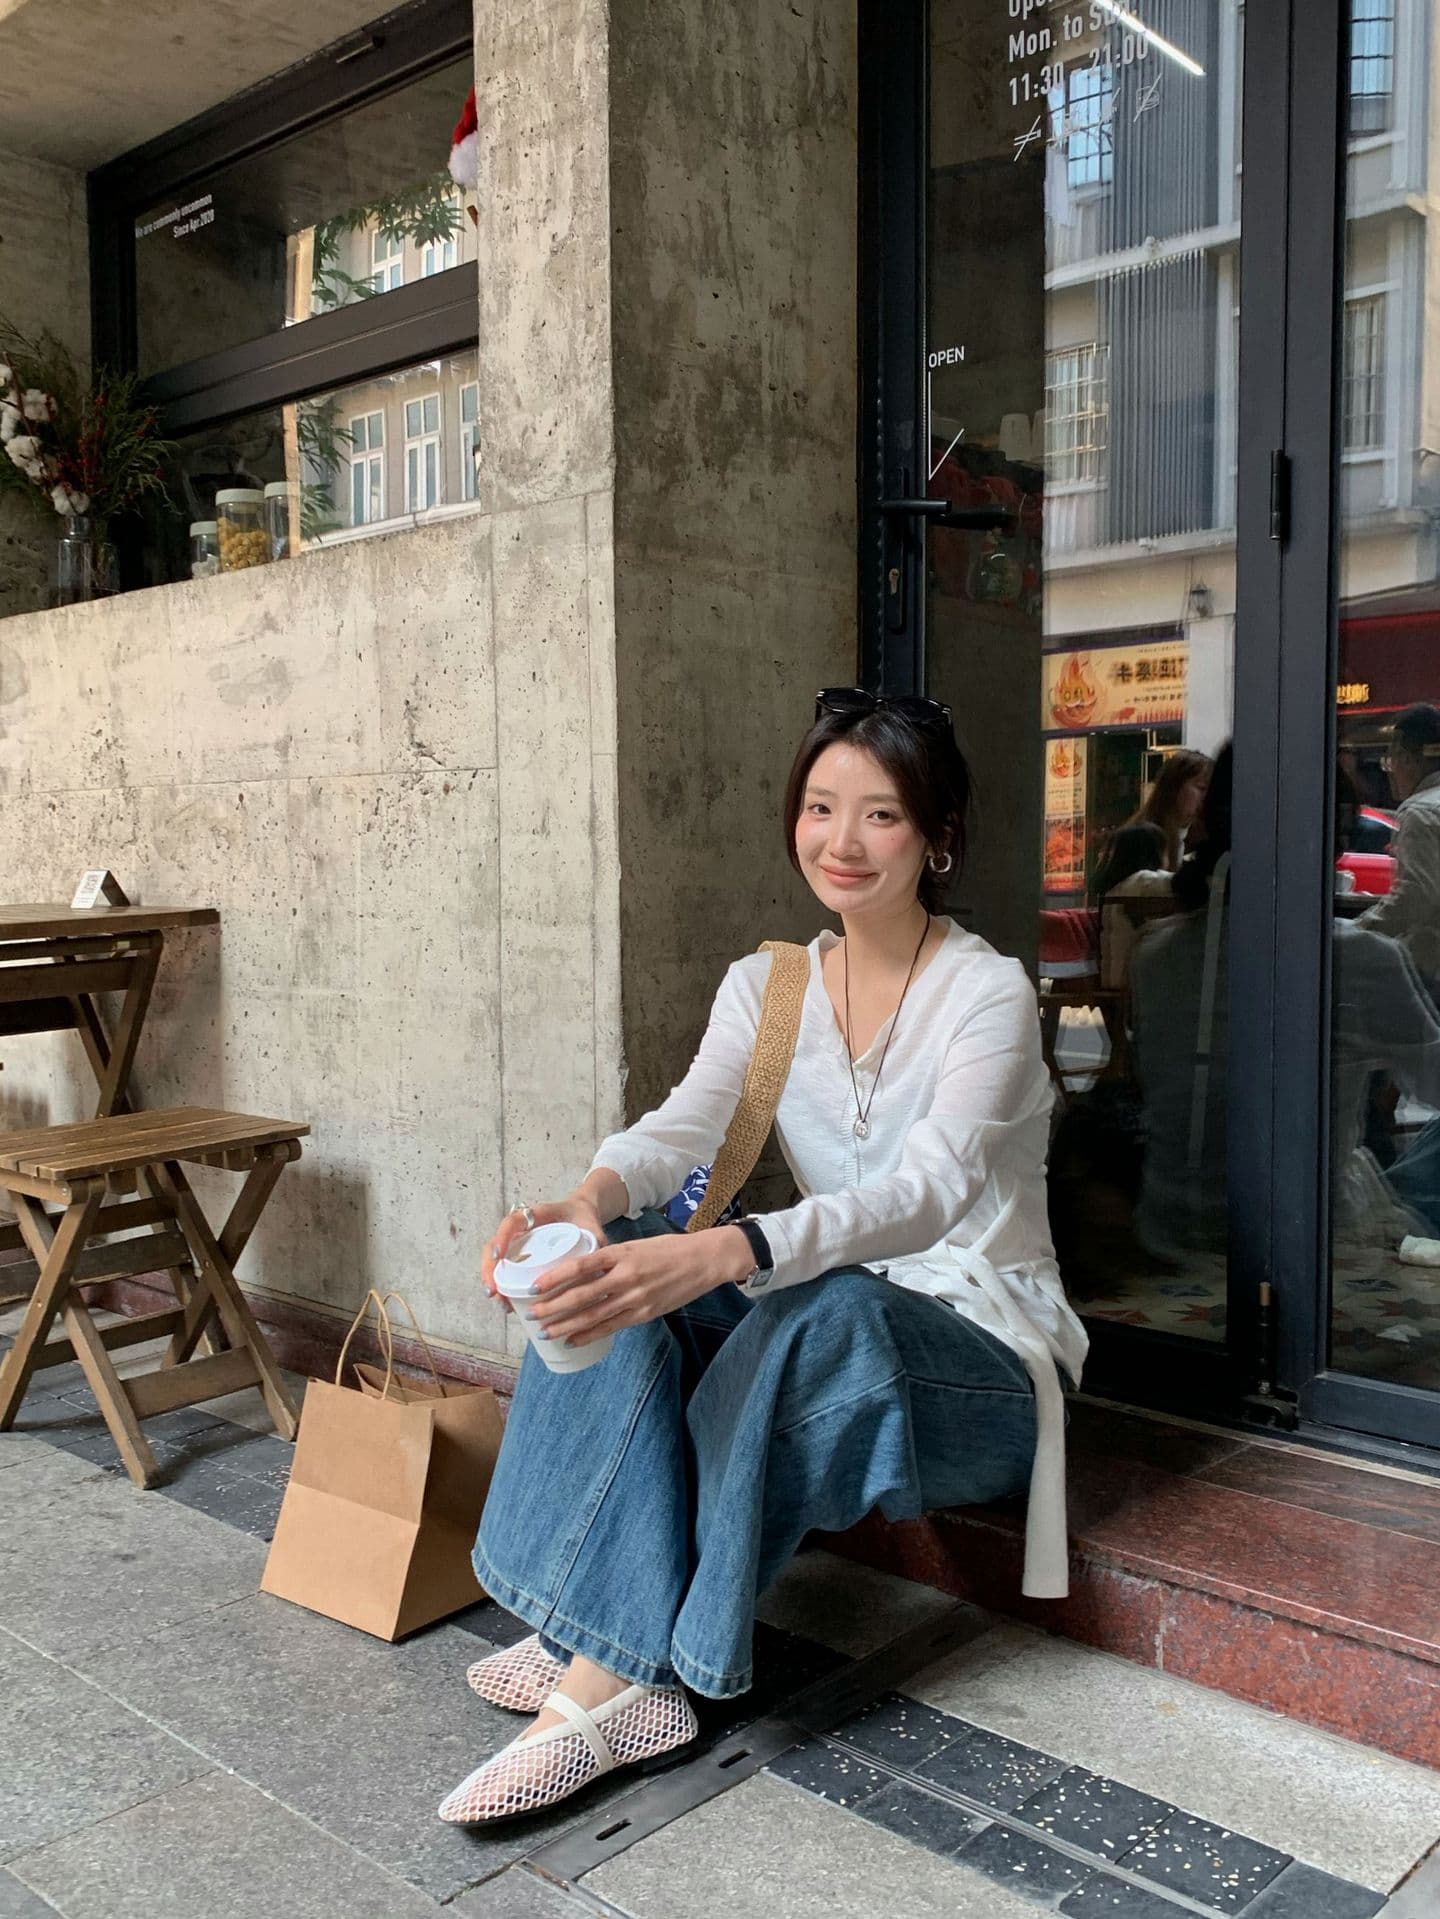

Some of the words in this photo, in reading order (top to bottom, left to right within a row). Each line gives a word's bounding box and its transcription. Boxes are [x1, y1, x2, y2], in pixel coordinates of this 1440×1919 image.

[1009, 28, 1058, 63] Mon.
[1063, 14, 1083, 41] to
[1009, 61, 1064, 106] 11:30
[1089, 31, 1149, 72] 21:00
[181, 194, 213, 217] uncommon
[173, 223, 189, 238] Since
[928, 345, 965, 368] OPEN
